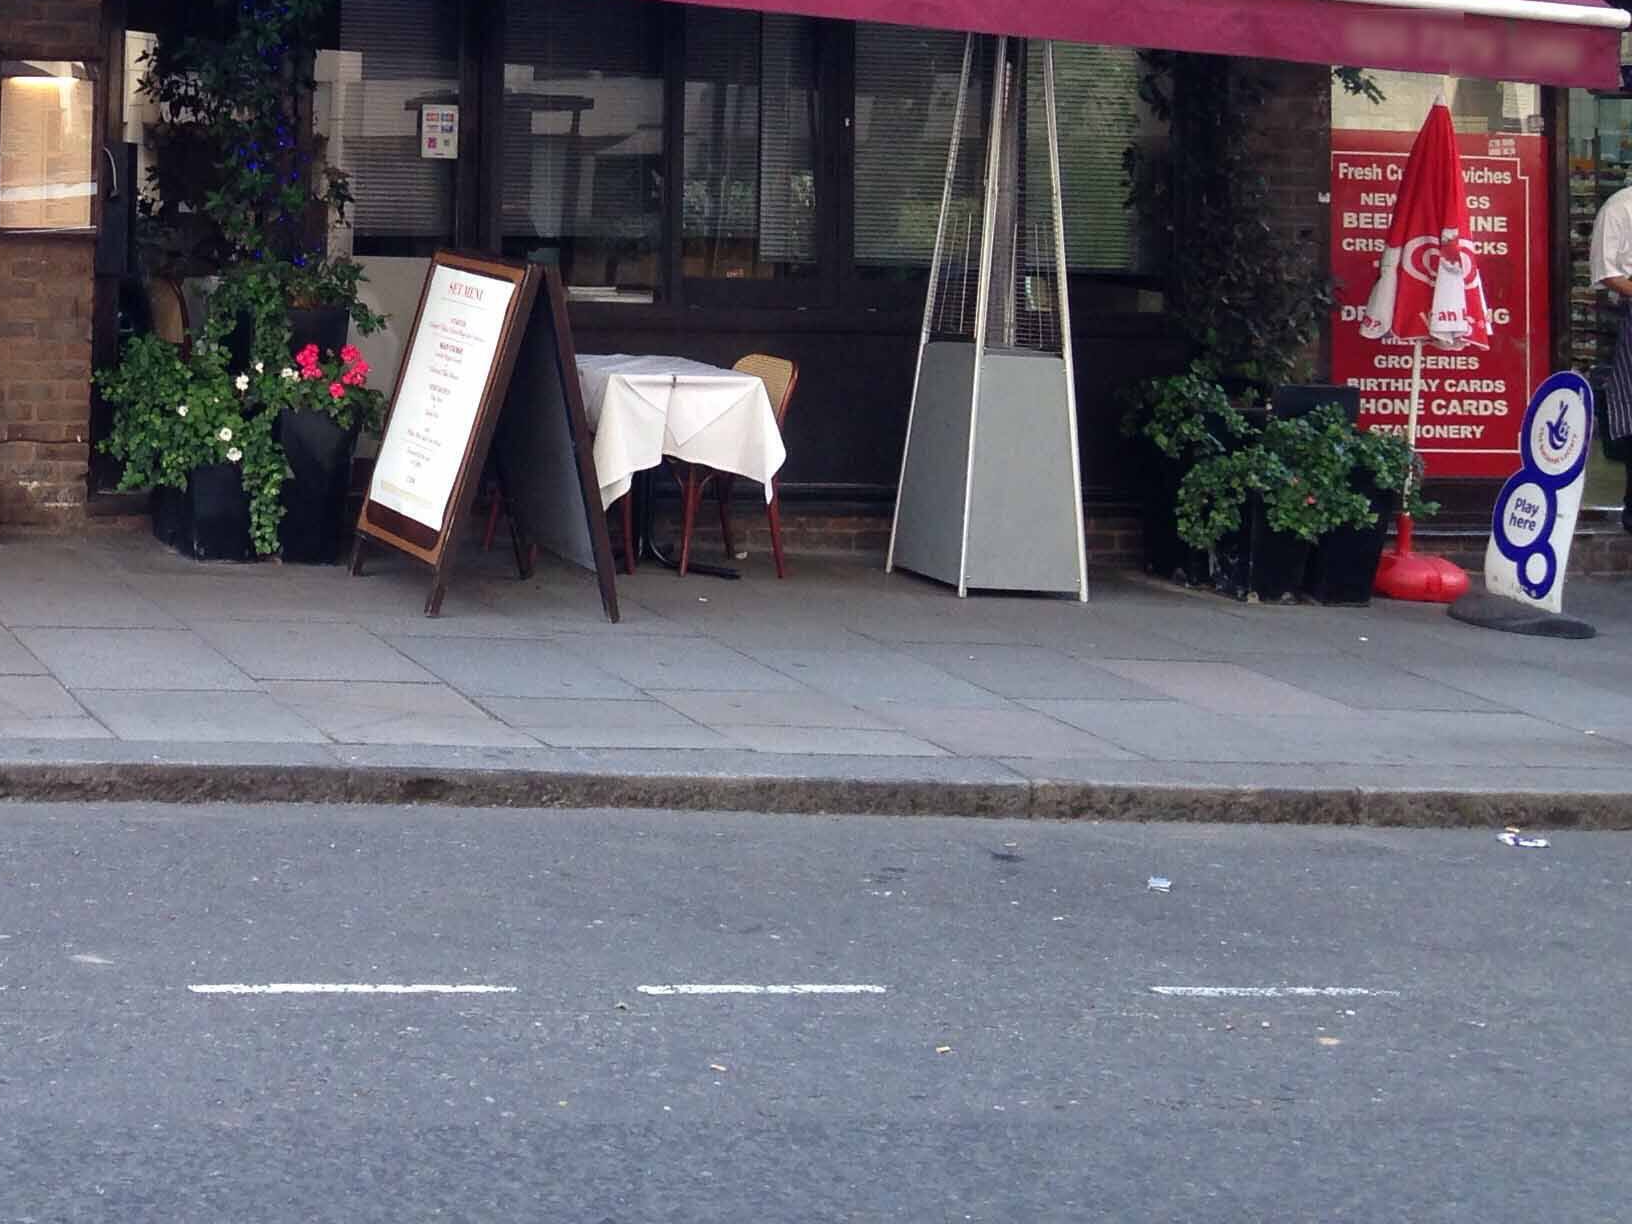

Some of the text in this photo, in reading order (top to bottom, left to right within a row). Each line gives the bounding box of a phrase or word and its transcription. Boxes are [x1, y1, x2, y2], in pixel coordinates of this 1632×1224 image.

[1338, 162, 1382, 180] Fresh
[1444, 379, 1506, 393] CARDS
[1359, 398, 1508, 416] HONE CARDS
[1514, 497, 1540, 518] Play
[1508, 513, 1537, 532] here
